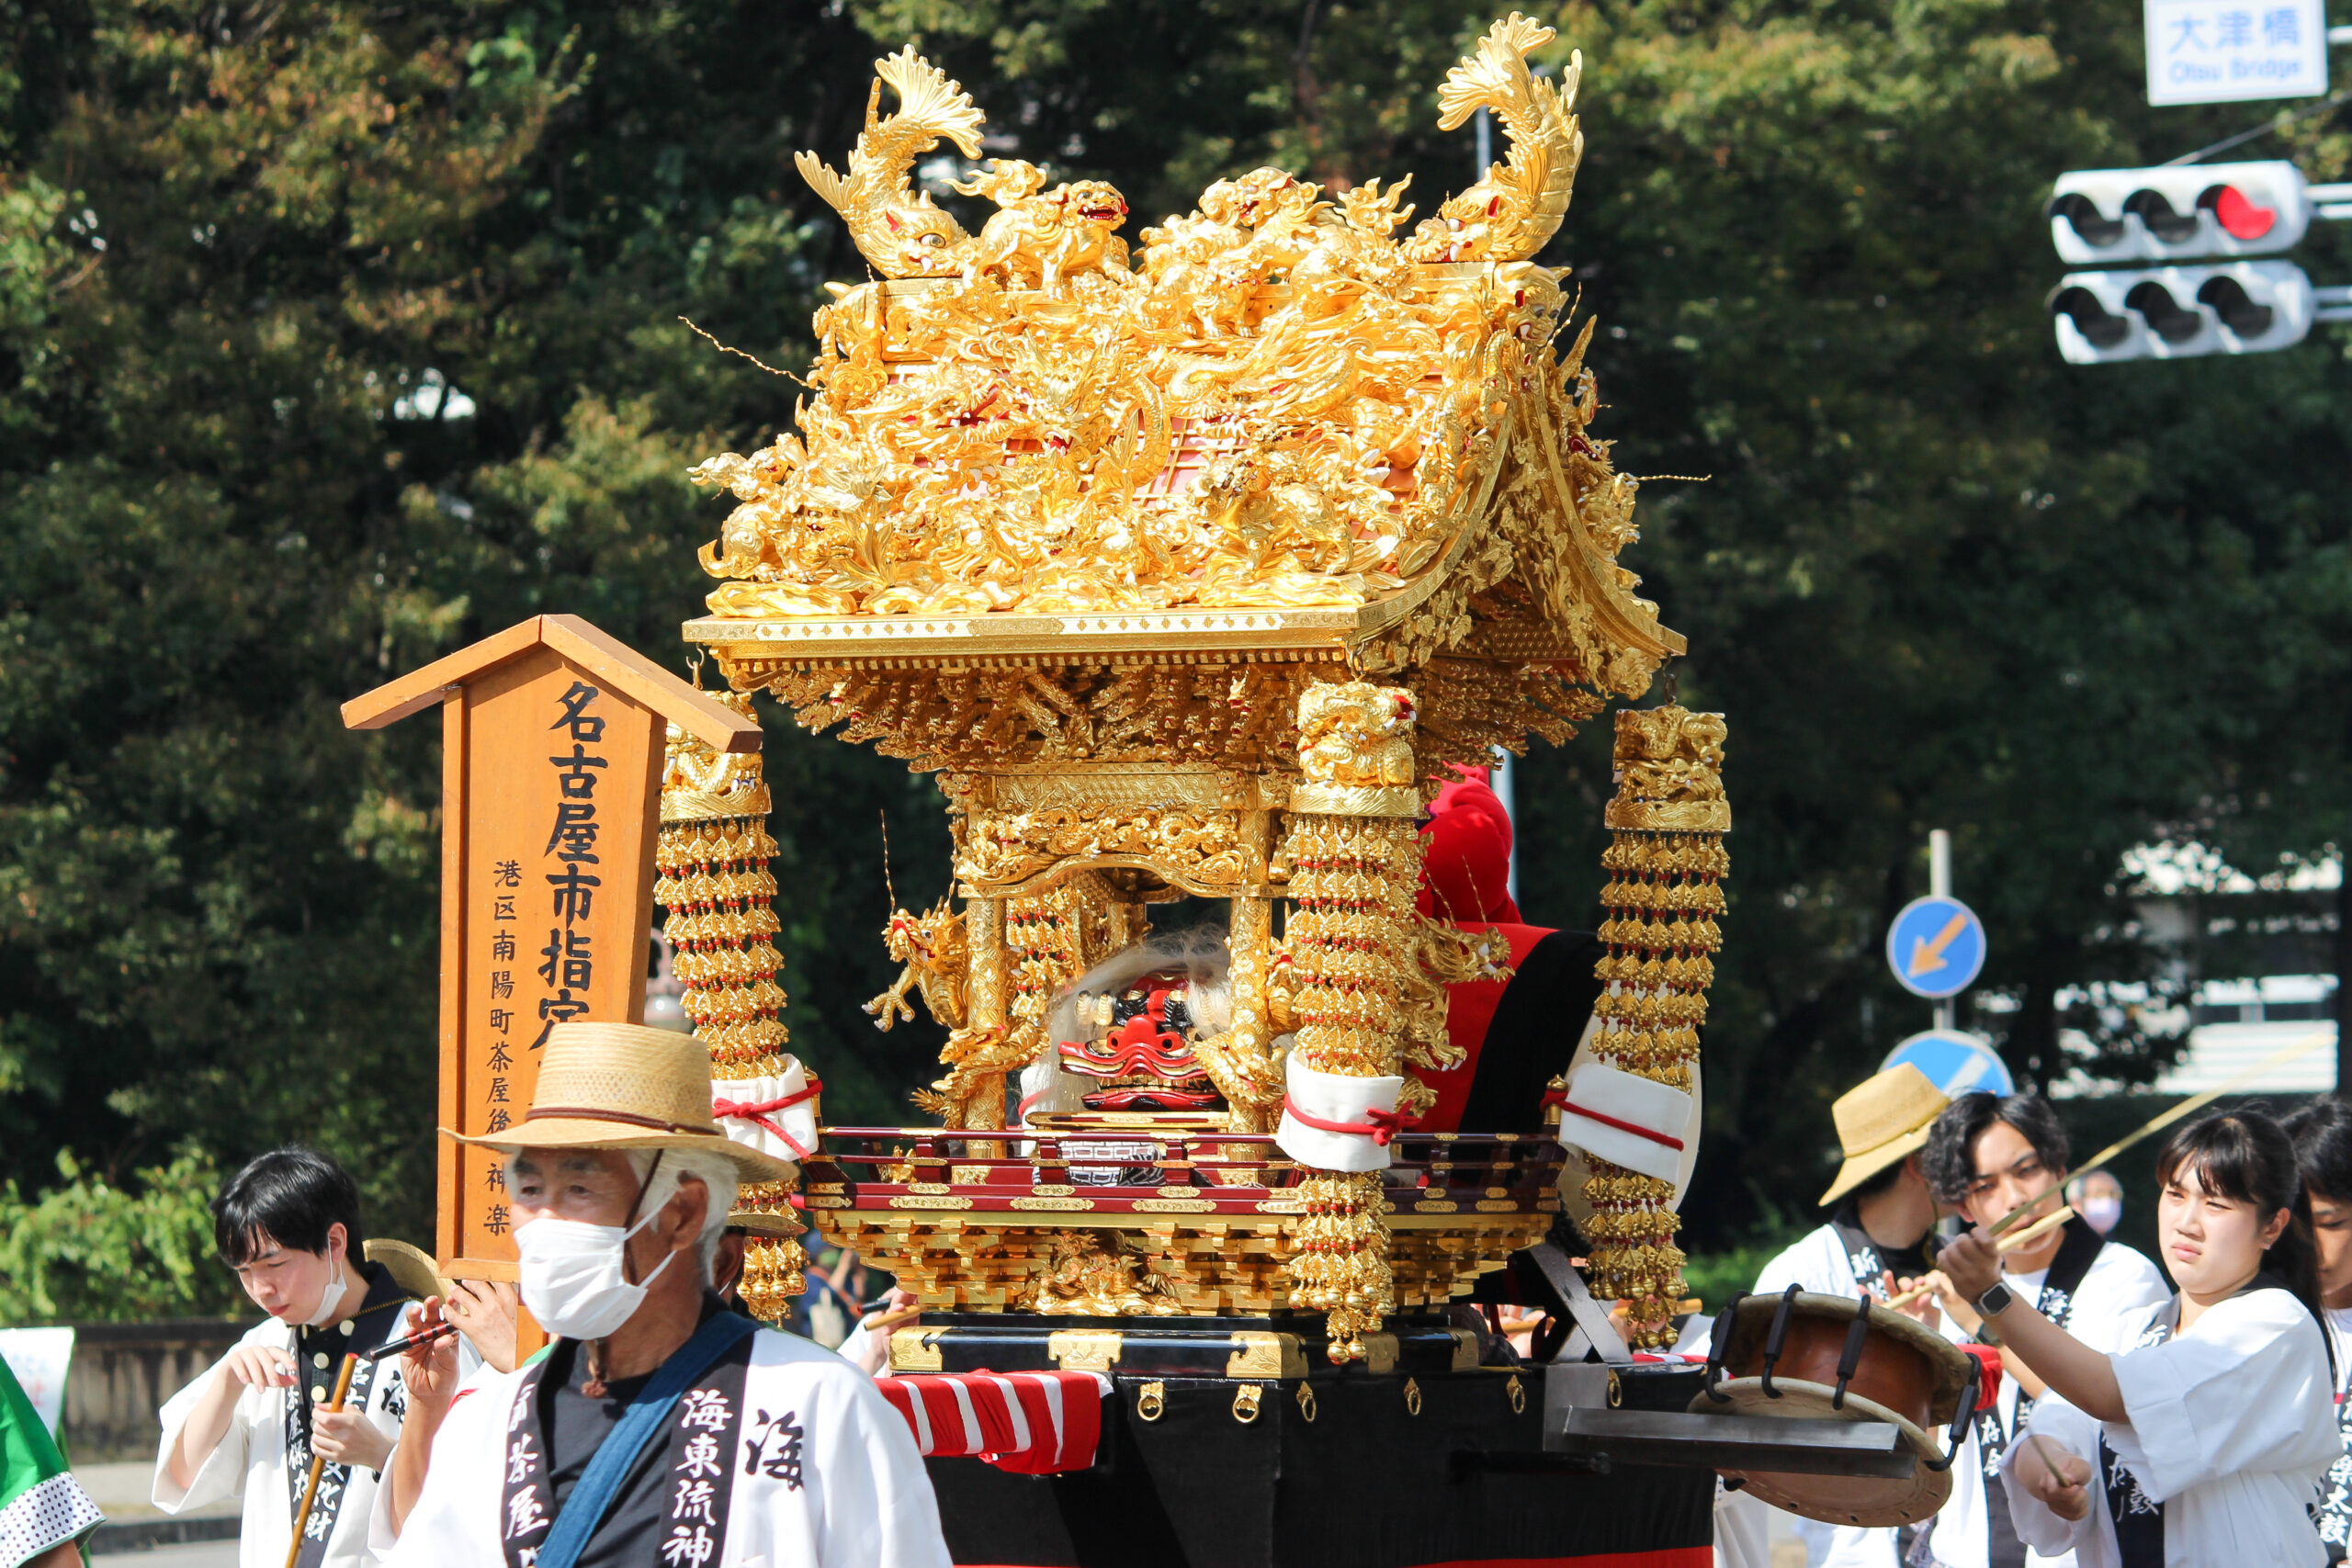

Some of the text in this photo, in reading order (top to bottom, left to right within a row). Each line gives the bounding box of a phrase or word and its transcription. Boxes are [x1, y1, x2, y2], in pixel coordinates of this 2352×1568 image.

[2166, 8, 2301, 54] 大津橋
[662, 1388, 733, 1568] 海東流神
